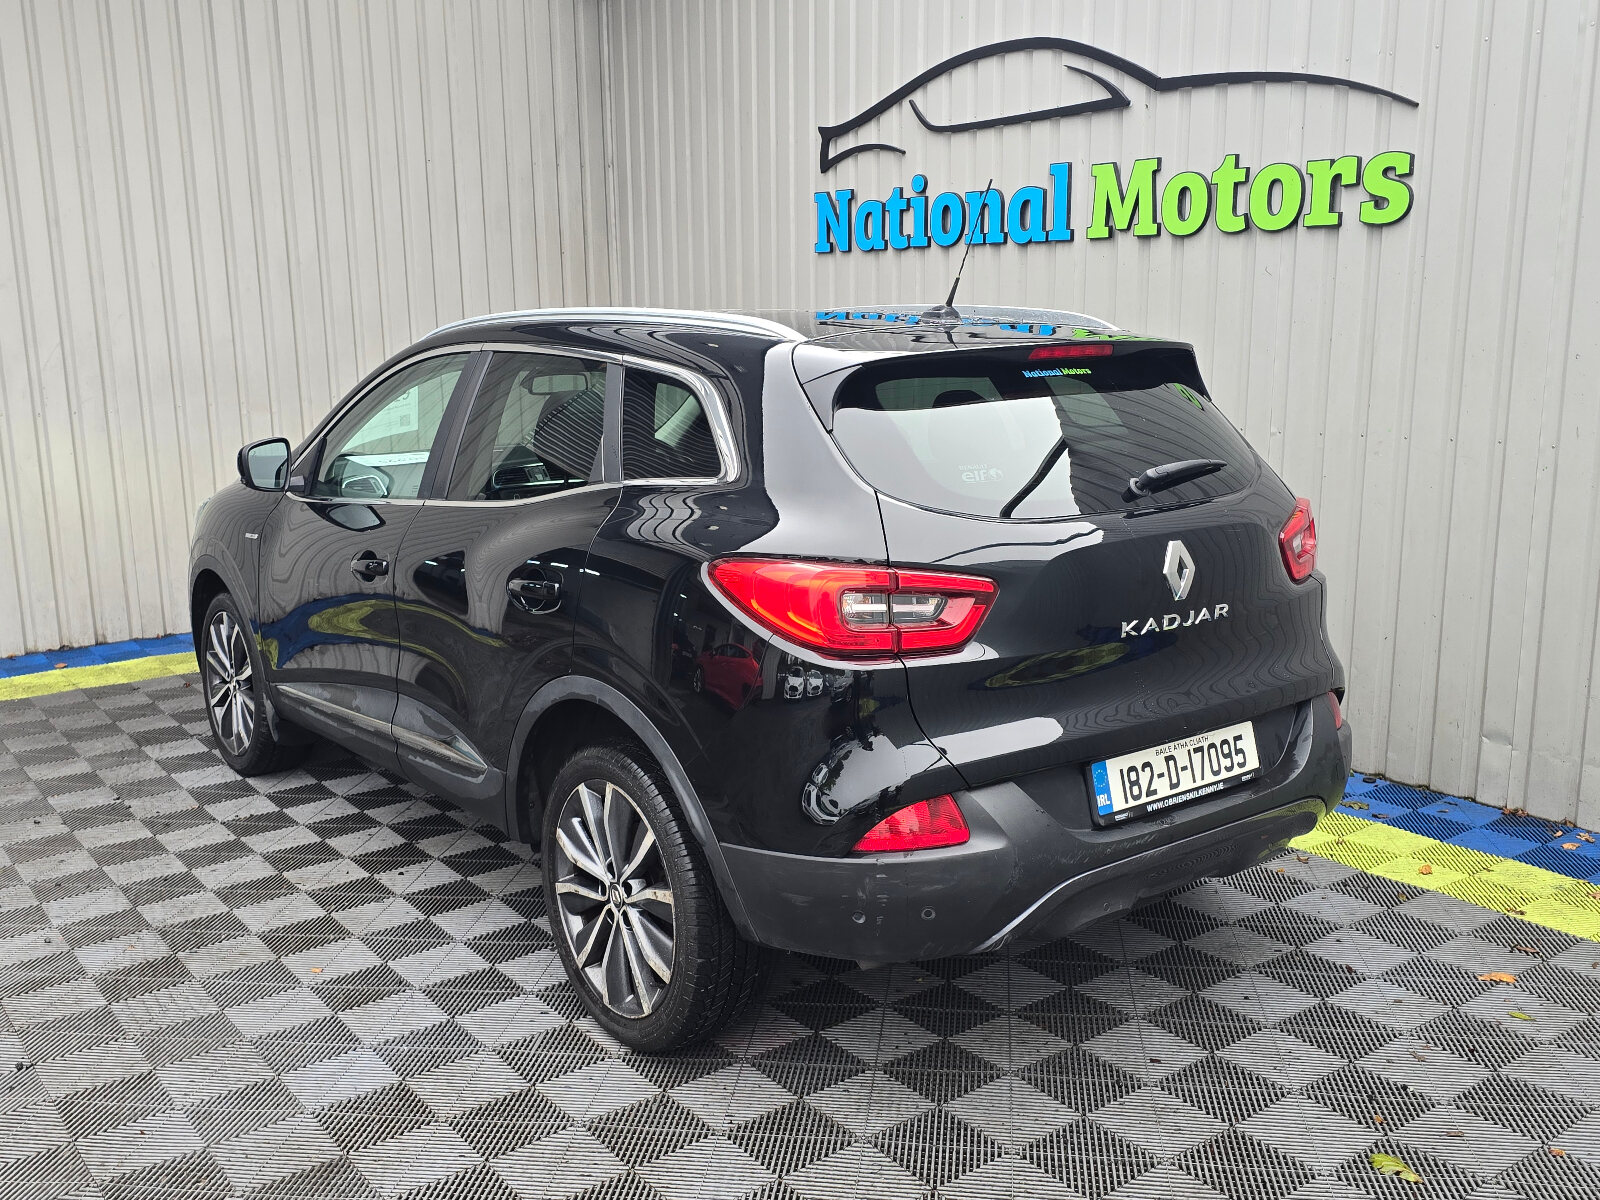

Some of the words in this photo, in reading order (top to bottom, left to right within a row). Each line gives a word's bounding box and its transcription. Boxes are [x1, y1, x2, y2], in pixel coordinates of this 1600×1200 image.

[815, 162, 1074, 253] National
[1087, 151, 1415, 239] Motors
[1022, 368, 1063, 378] National
[1060, 367, 1091, 375] Motors
[961, 469, 987, 482] elf
[1120, 603, 1229, 638] KADJAR
[1119, 733, 1247, 805] 182-D-17095
[1096, 793, 1111, 807] IRL
